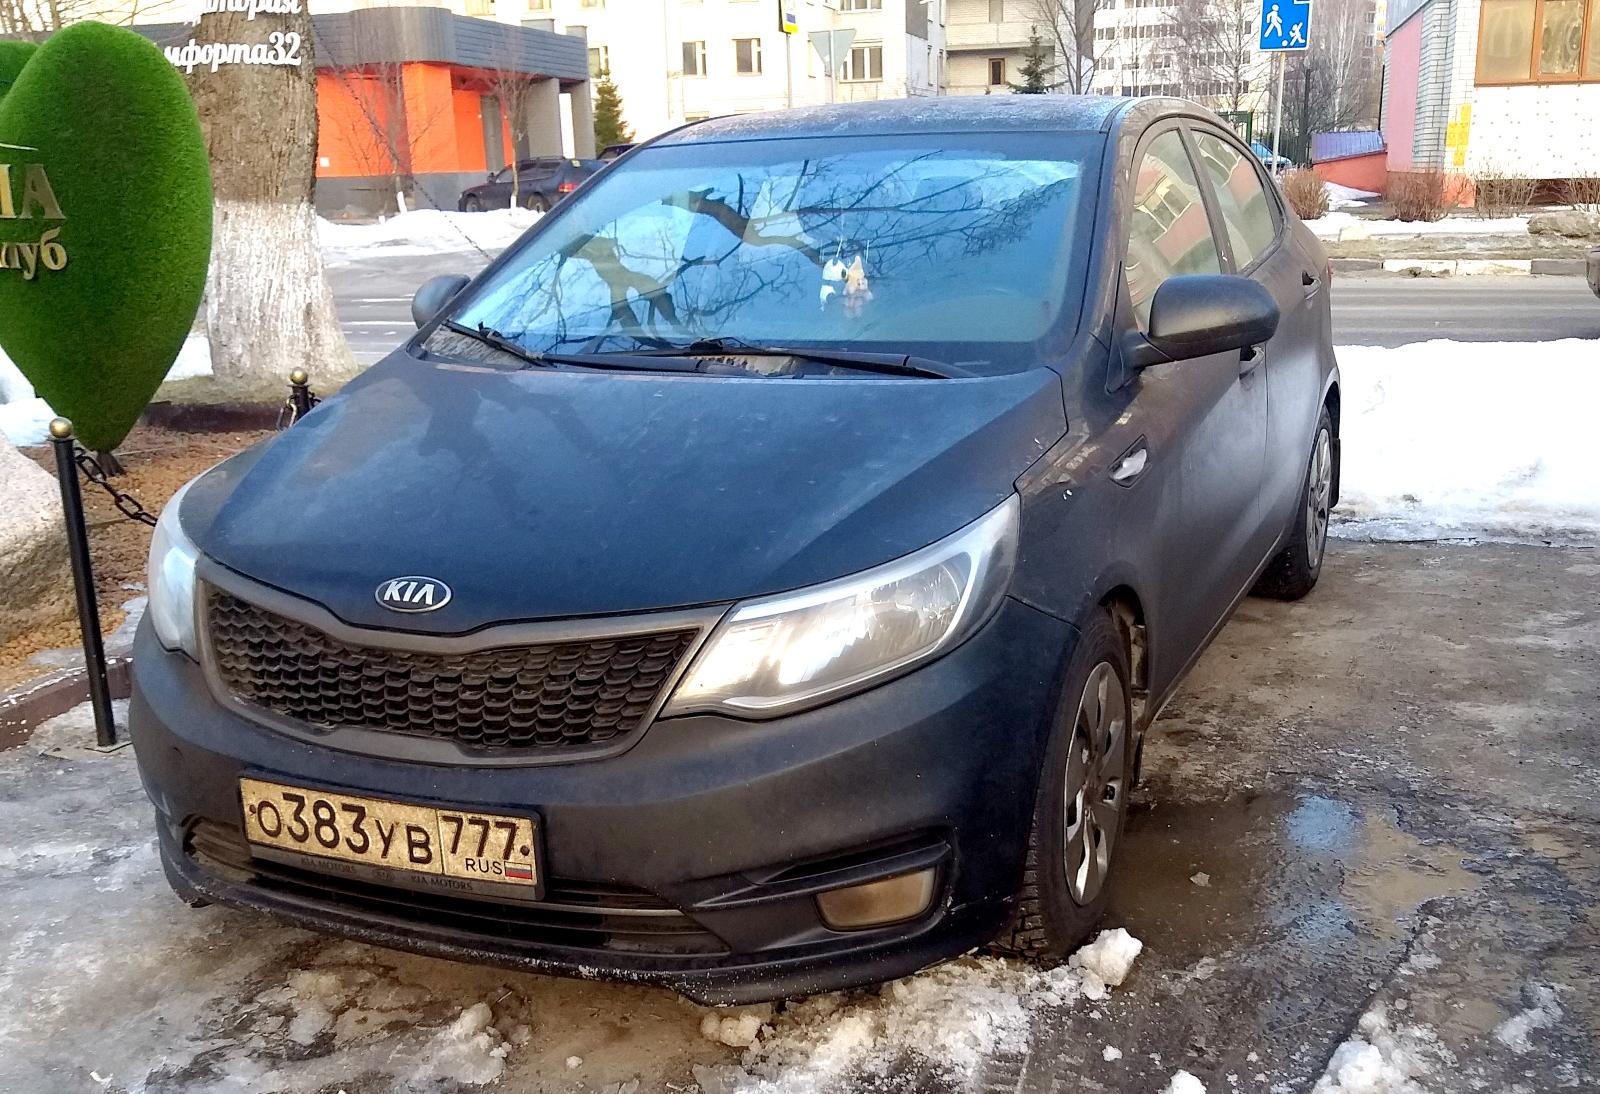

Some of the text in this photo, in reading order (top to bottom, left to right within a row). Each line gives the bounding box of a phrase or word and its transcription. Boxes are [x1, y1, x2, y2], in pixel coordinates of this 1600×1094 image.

[382, 580, 435, 606] KIA
[442, 815, 517, 860] 777
[465, 858, 503, 875] RUS
[431, 878, 473, 890] MOTORS
